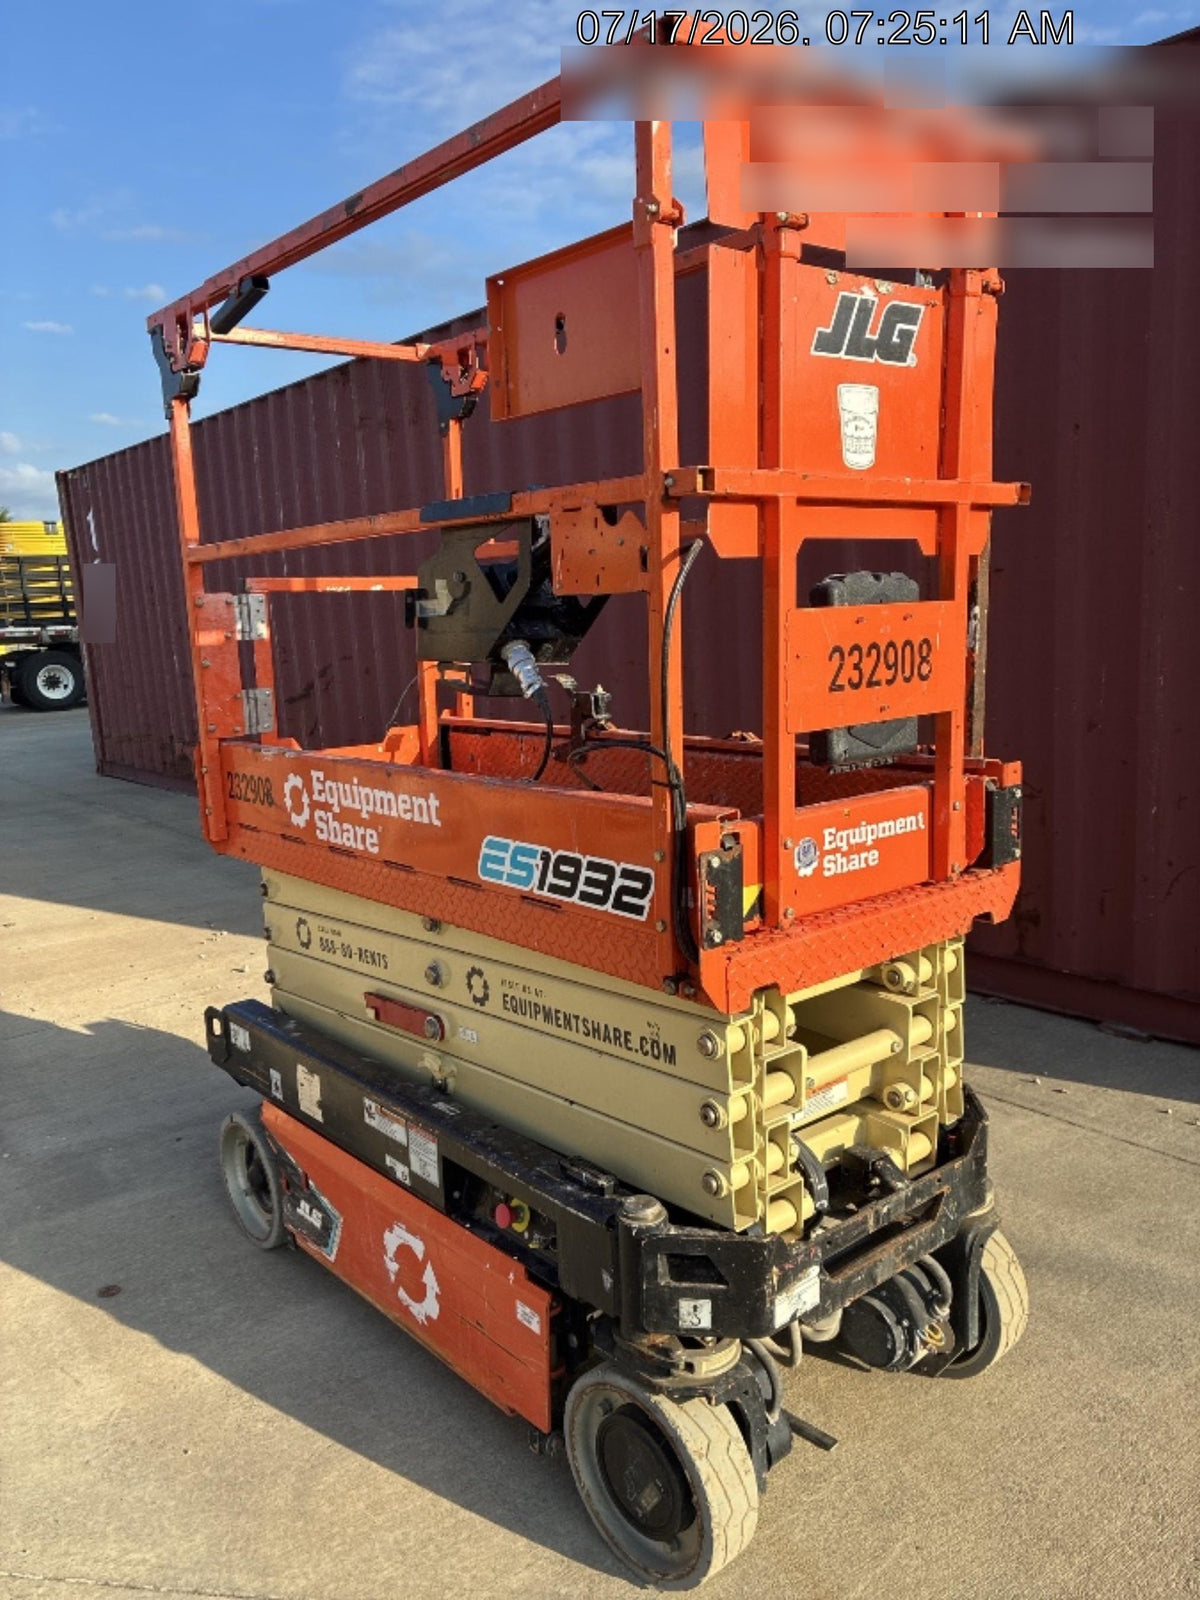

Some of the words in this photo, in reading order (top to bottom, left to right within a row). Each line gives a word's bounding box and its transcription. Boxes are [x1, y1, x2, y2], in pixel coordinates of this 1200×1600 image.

[811, 291, 925, 367] JLG
[828, 637, 932, 693] 232908
[227, 771, 274, 807] 232908
[311, 770, 441, 827] Equipment
[313, 809, 380, 854] Share
[823, 811, 926, 852] Equipment
[478, 835, 654, 921] ES1932
[823, 849, 879, 877] Share
[502, 993, 677, 1066] EQUIPMENTSHARE.COM
